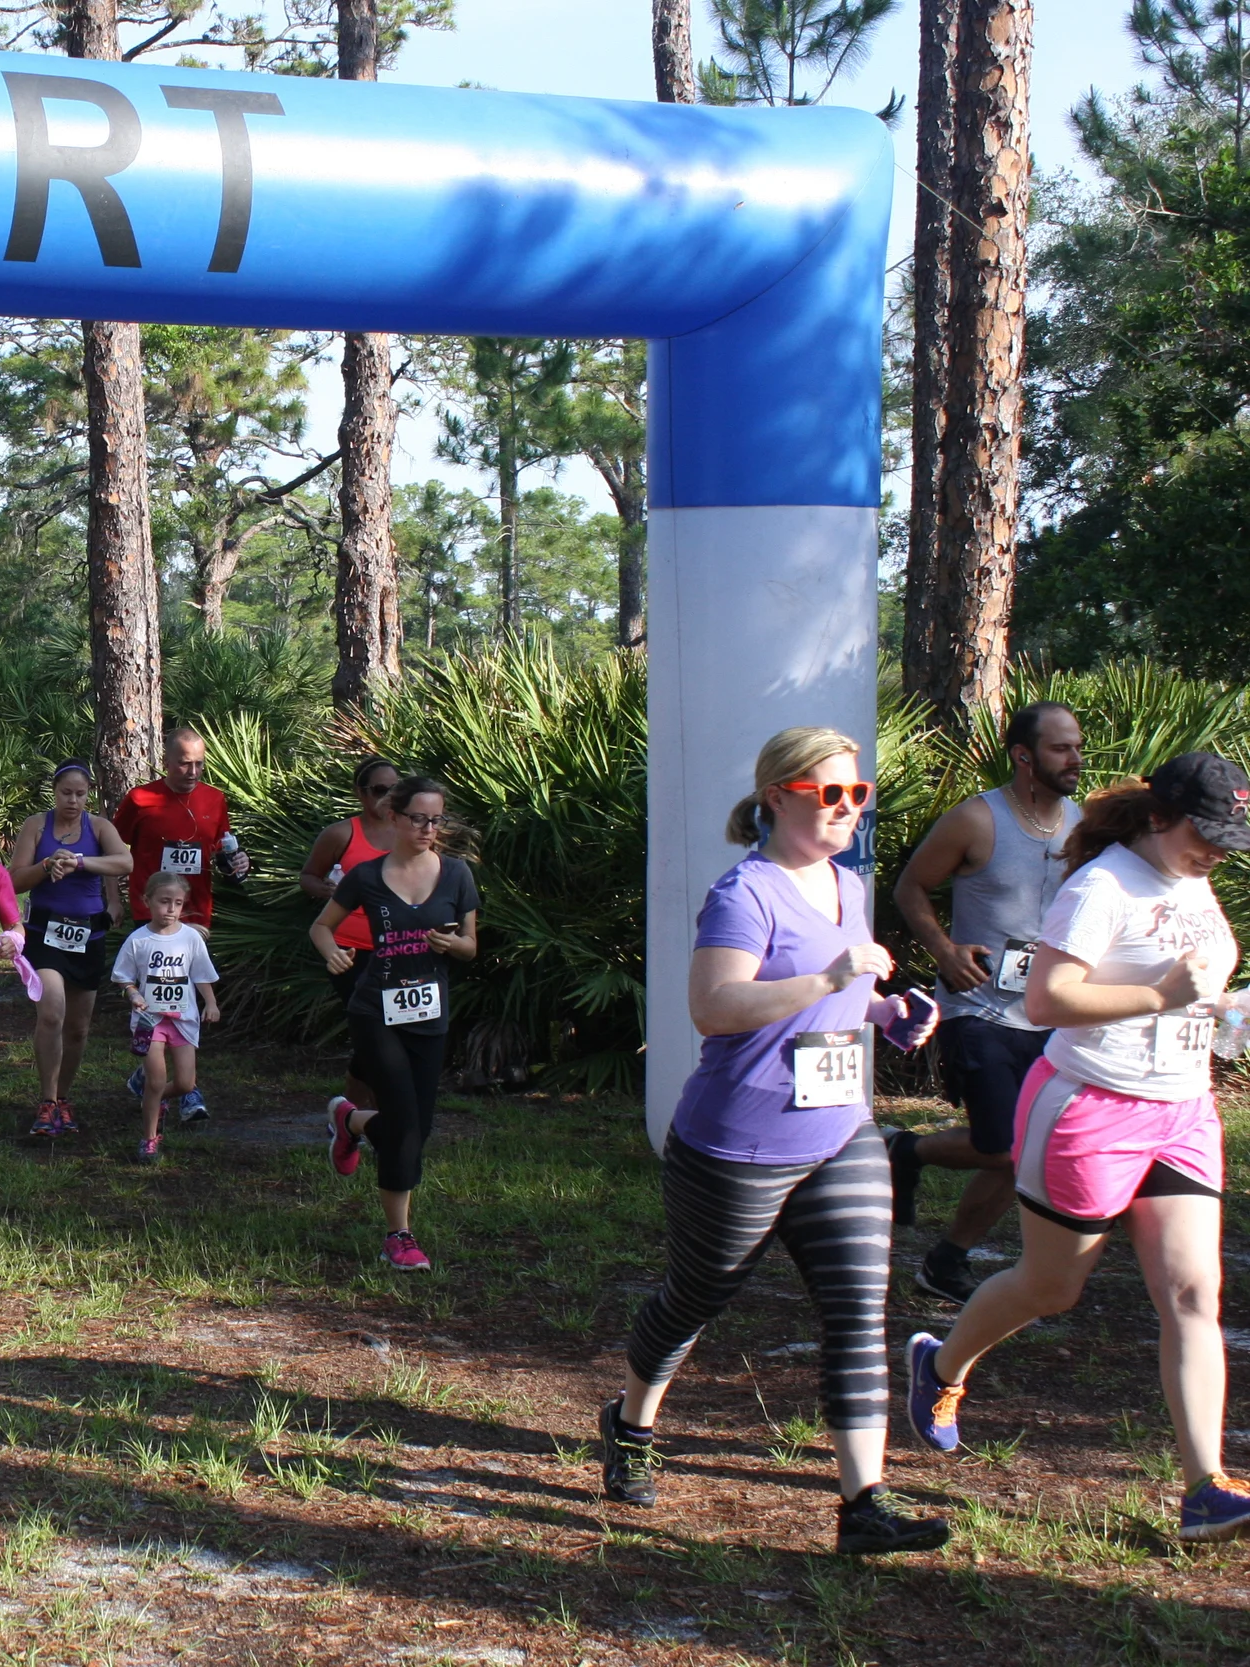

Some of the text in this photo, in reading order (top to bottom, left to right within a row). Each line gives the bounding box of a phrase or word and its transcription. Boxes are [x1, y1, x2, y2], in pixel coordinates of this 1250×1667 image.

[170, 849, 197, 865] 407
[54, 924, 85, 943] 406
[1158, 928, 1218, 951] HAPPY
[376, 942, 429, 958] CANCER
[148, 951, 184, 969] Bad
[152, 985, 184, 1001] 409
[393, 986, 433, 1010] 405
[816, 1048, 857, 1082] 414
